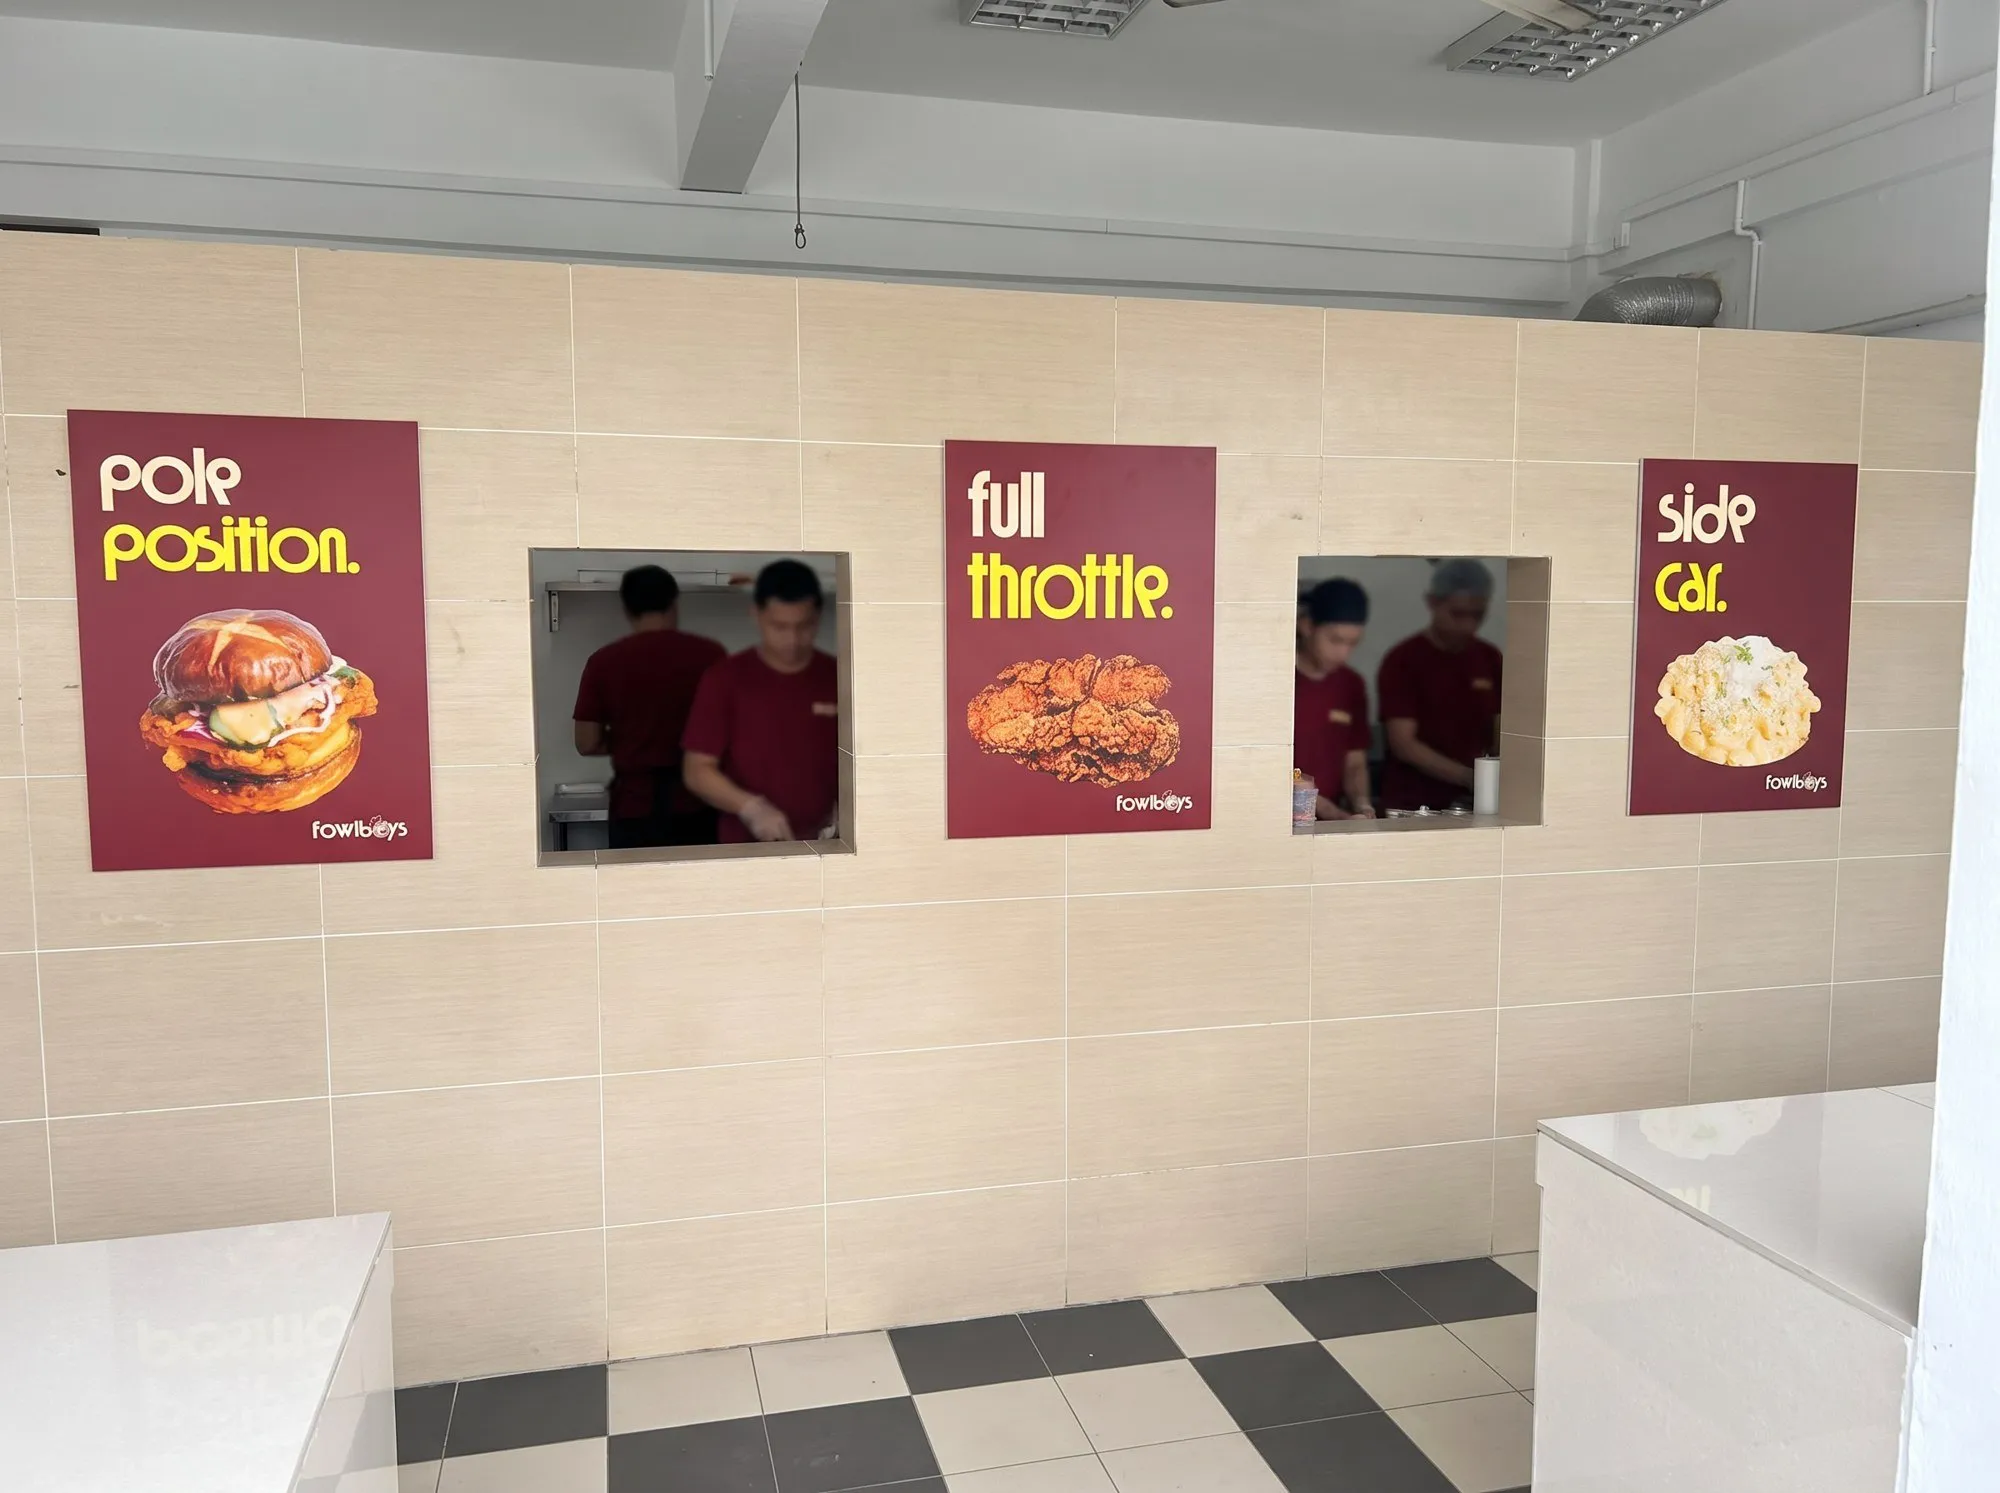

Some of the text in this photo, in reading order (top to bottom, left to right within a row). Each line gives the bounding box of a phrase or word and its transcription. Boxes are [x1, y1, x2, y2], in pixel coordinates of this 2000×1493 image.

[99, 447, 242, 512] pole
[967, 470, 1045, 538] full
[1657, 482, 1756, 544] side
[103, 515, 361, 581] position.
[967, 552, 1174, 620] throttle.
[1654, 562, 1728, 613] car.
